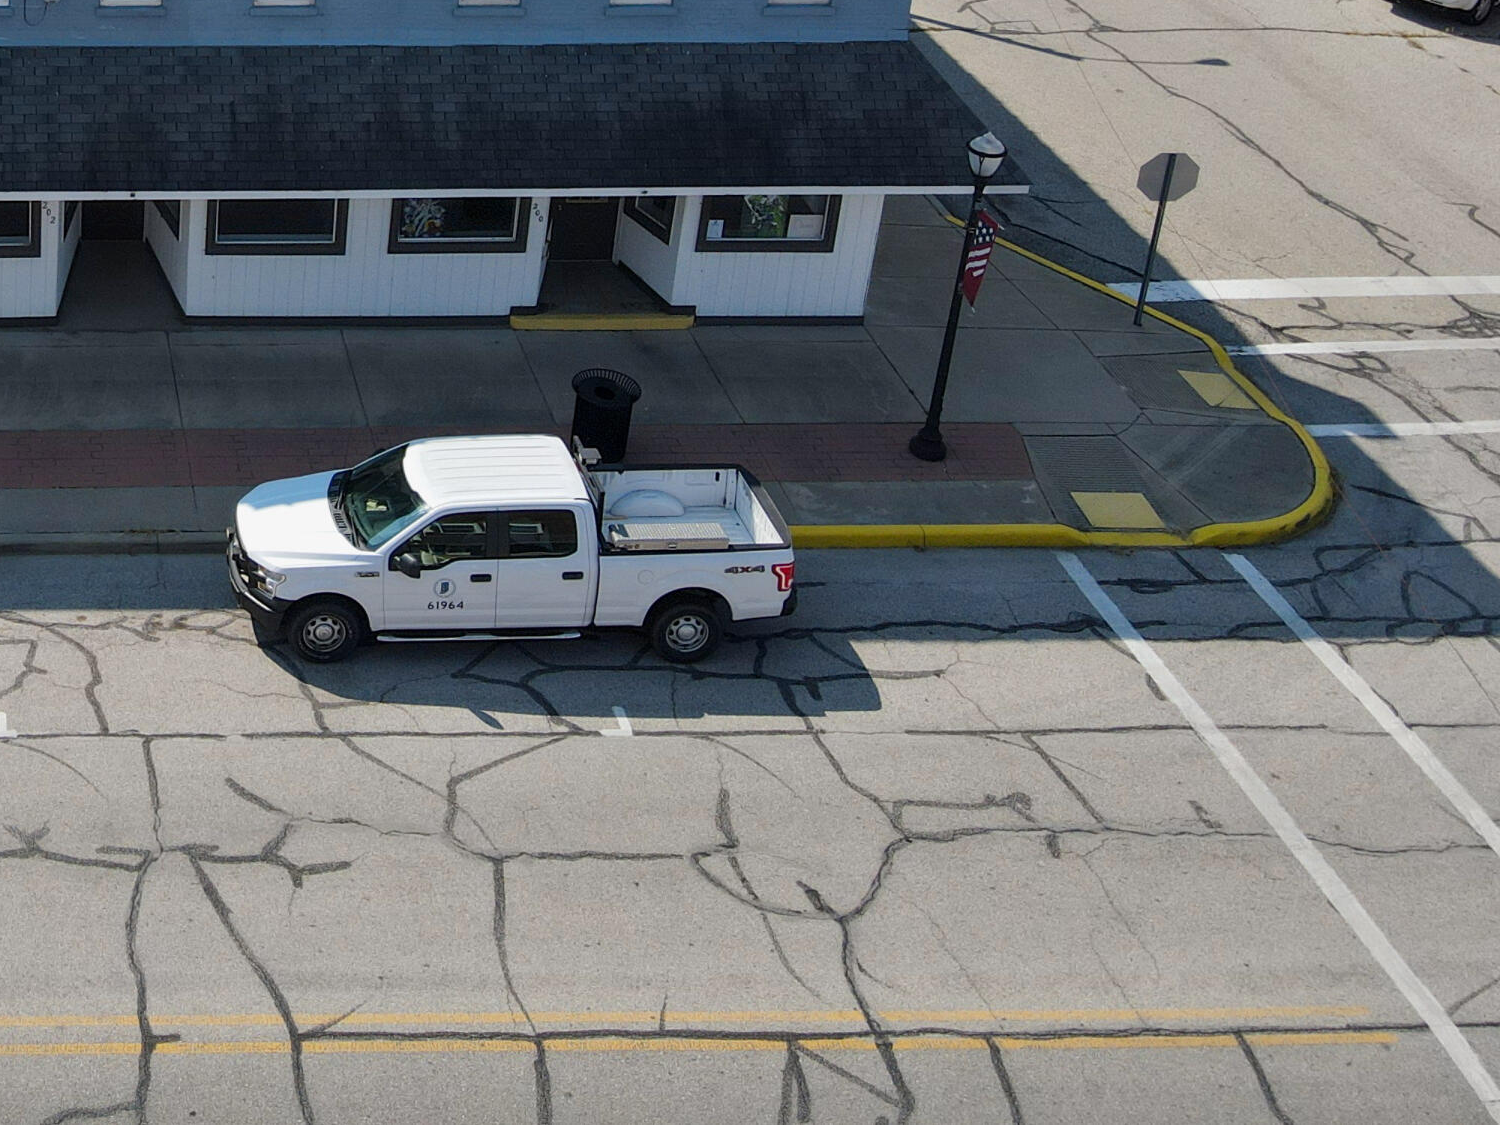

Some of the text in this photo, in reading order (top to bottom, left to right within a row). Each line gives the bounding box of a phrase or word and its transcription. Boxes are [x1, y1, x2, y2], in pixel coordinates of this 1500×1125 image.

[42, 201, 56, 224] 202
[532, 203, 544, 222] 200
[427, 600, 464, 610] 61964
